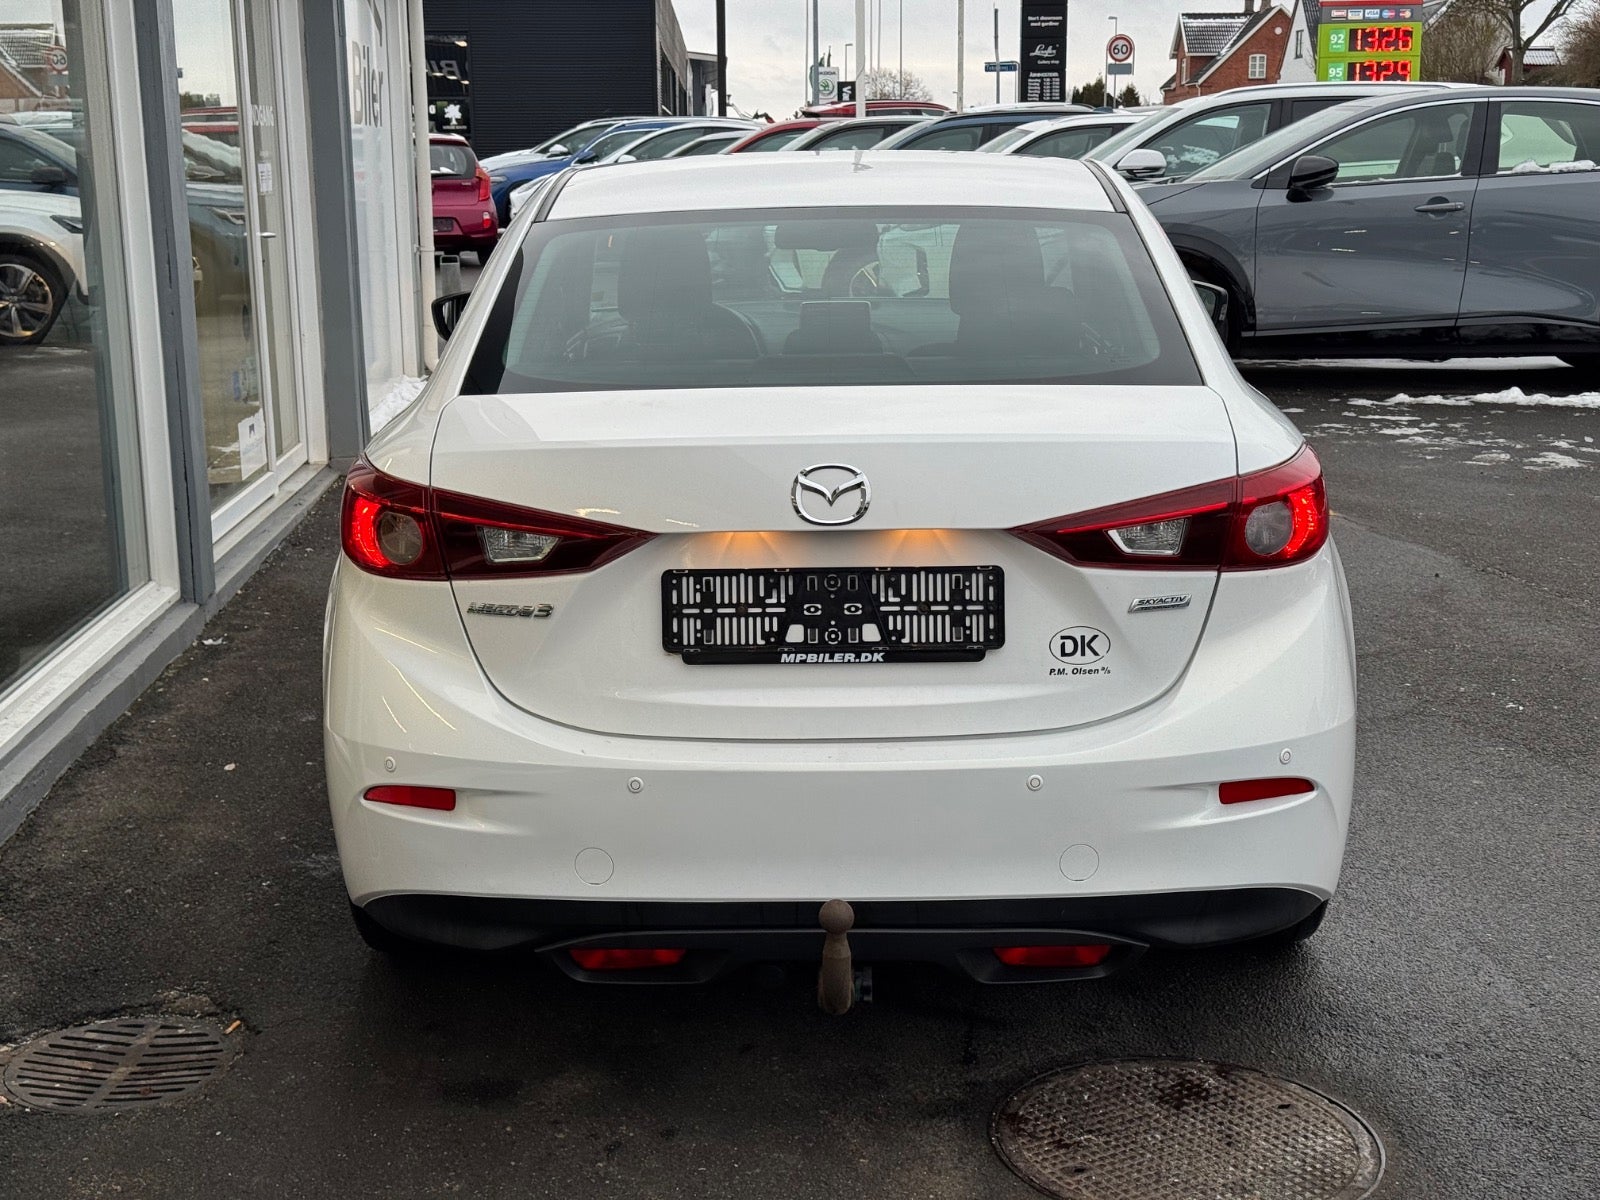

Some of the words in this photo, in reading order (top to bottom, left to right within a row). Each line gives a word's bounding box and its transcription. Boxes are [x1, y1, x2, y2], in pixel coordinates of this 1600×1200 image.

[1330, 33, 1345, 44] 92
[1113, 44, 1128, 55] 60
[1328, 67, 1343, 78] 95
[351, 40, 384, 128] Biler
[1136, 595, 1187, 606] SKYACTIV
[1060, 634, 1100, 657] DK
[780, 652, 886, 663] MPBILER.DK
[1049, 668, 1068, 676] P.M.
[1071, 667, 1099, 675] Olsen
